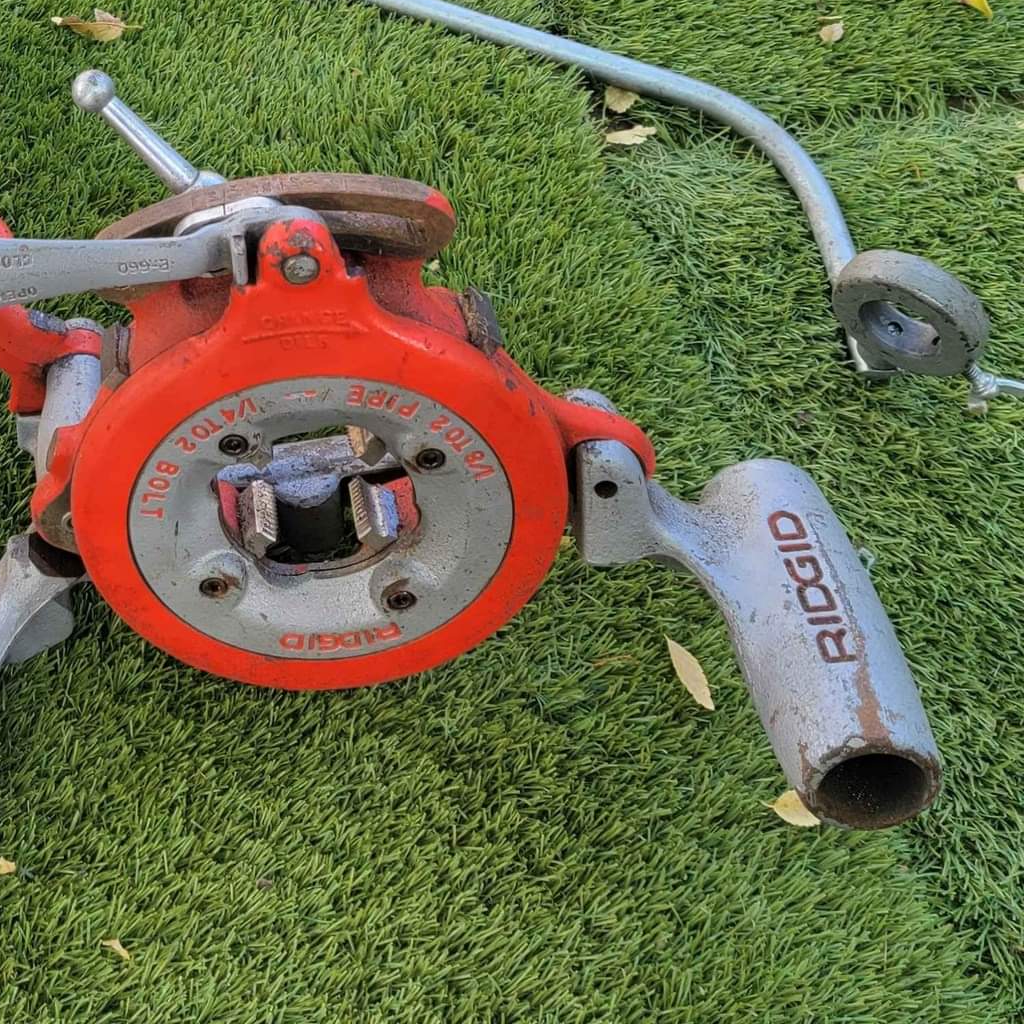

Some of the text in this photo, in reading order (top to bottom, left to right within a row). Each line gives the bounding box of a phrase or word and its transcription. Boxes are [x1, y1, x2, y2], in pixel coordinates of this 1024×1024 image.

[345, 383, 421, 419] PIPE
[138, 459, 181, 521] BOLT
[766, 509, 858, 665] RIDGID
[279, 622, 402, 652] RIDGID
